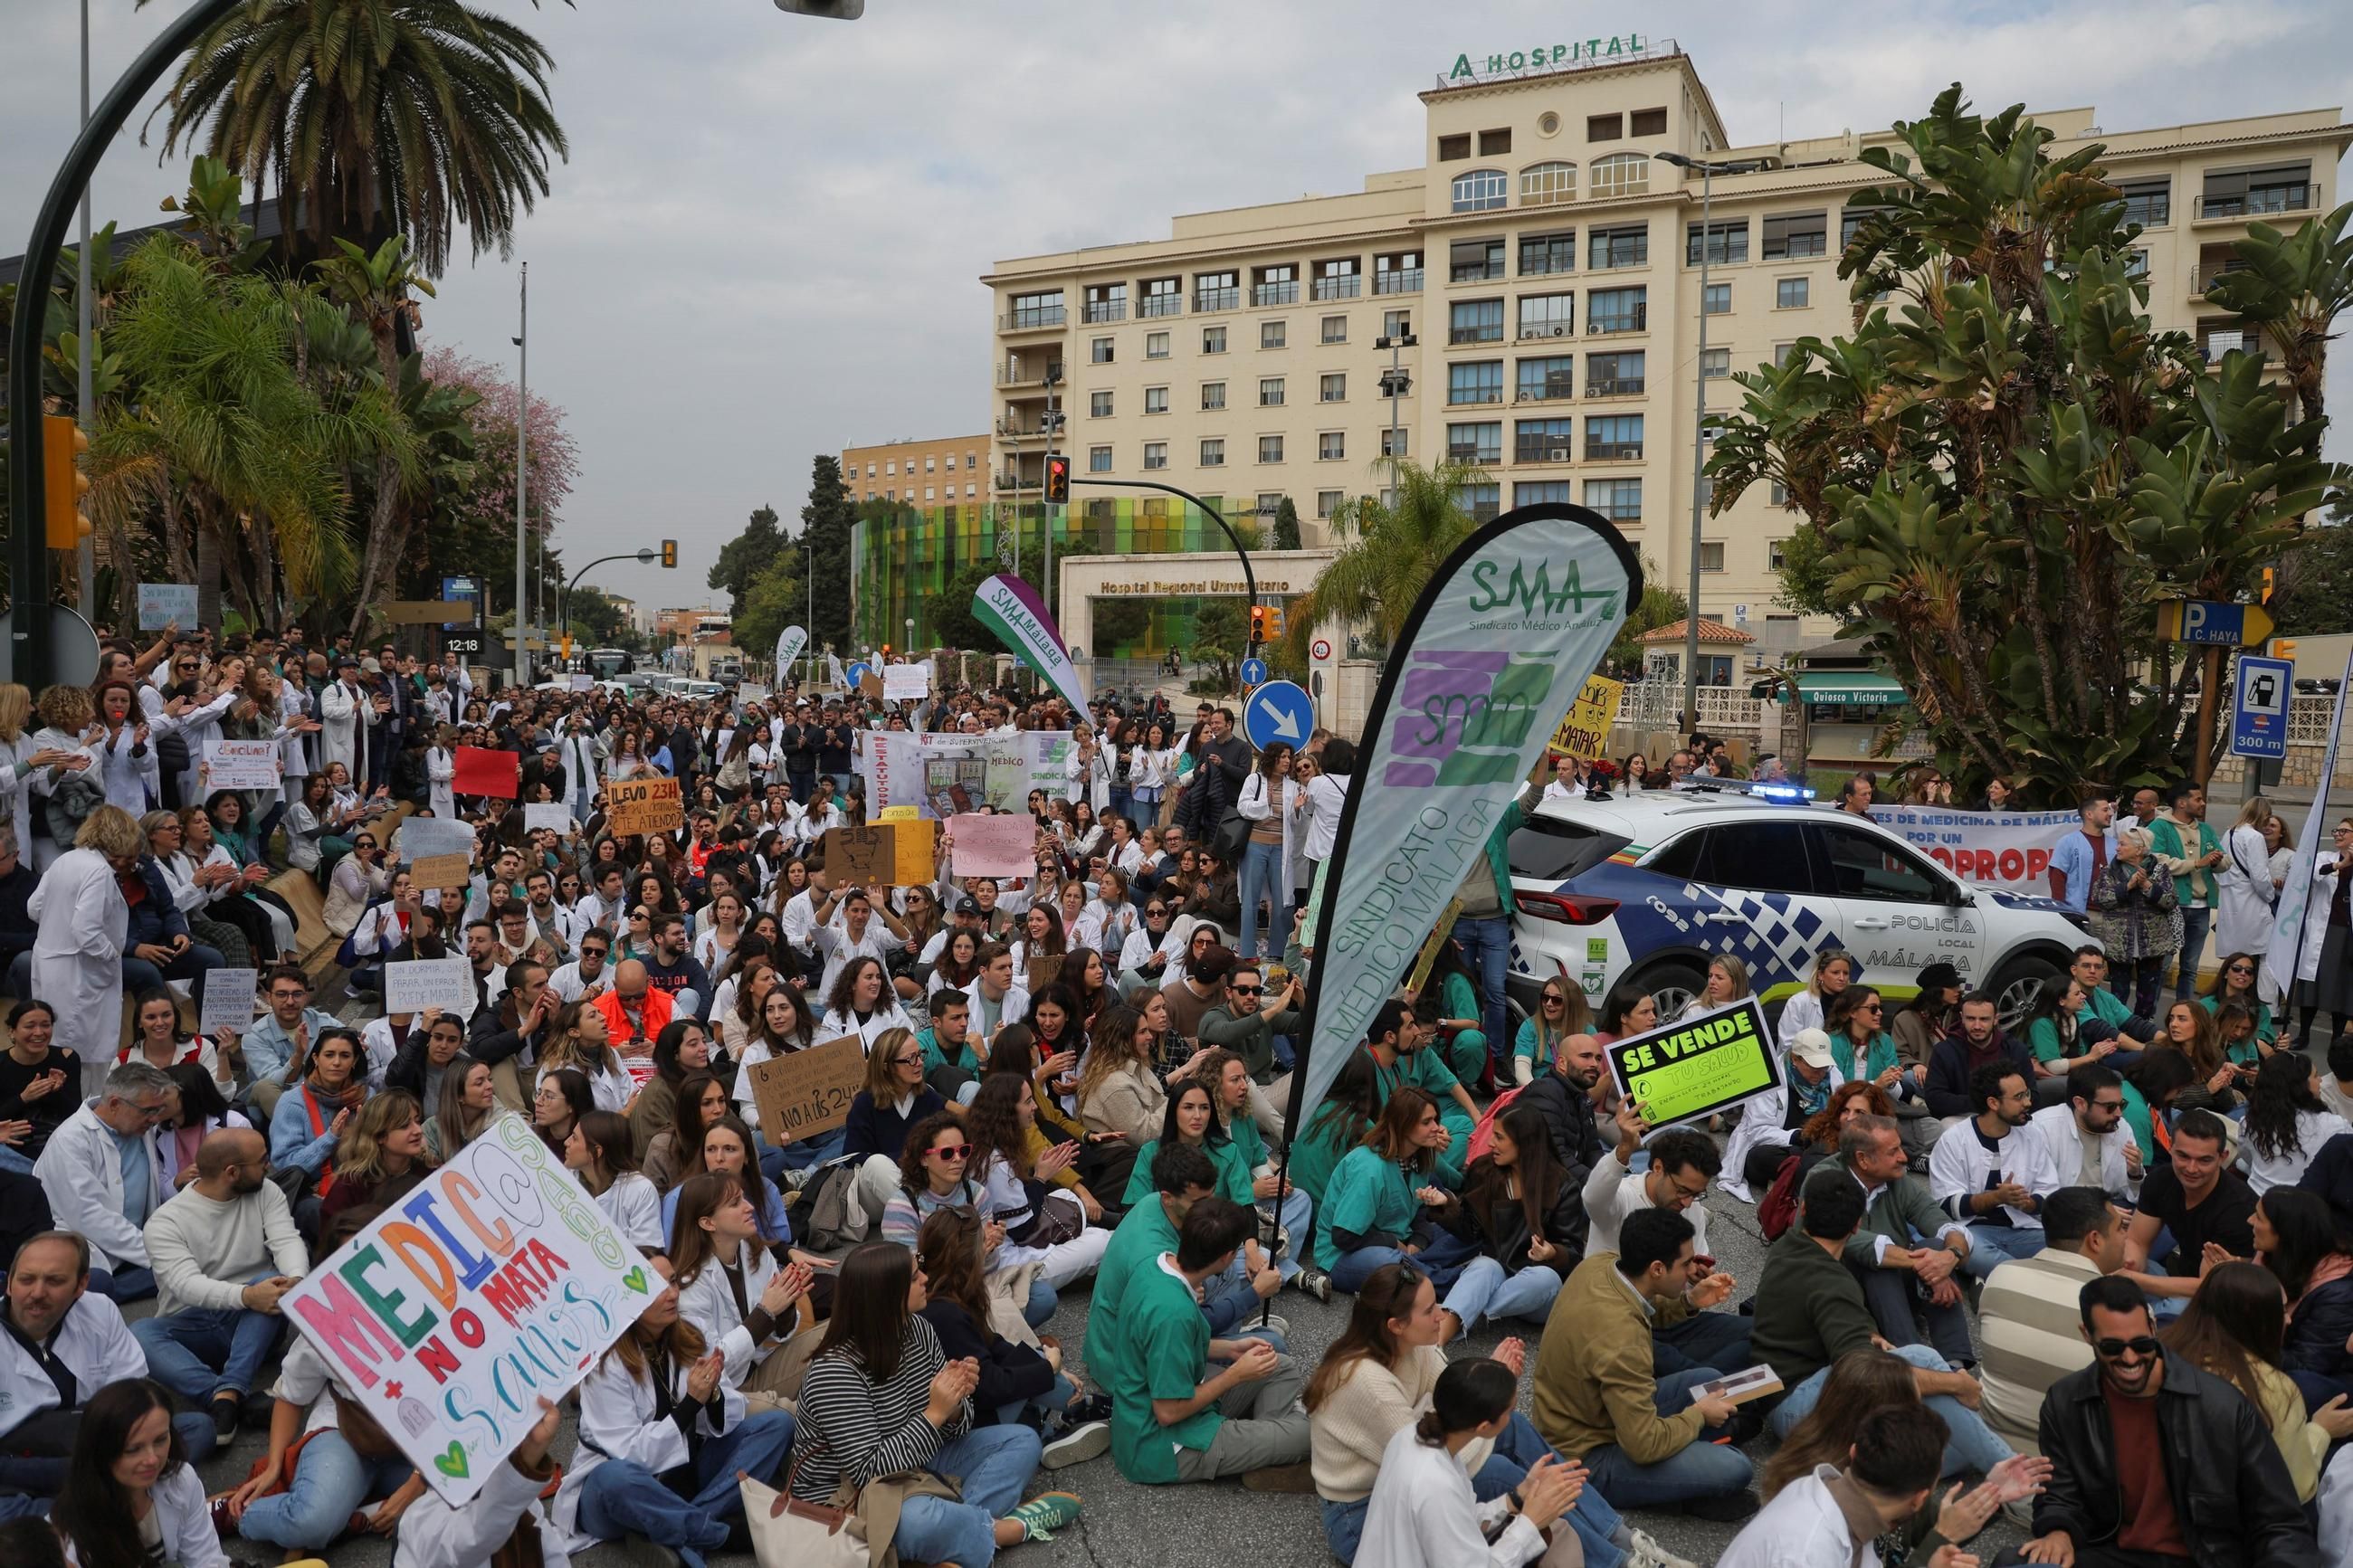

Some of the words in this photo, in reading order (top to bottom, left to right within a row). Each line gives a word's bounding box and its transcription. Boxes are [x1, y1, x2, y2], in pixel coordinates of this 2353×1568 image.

[1488, 33, 1643, 73] HOSPITAL
[1101, 582, 1149, 594] Hospital
[1154, 581, 1206, 594] Regional
[1210, 580, 1289, 593] Univeritario
[1470, 556, 1586, 619] SMA
[1470, 620, 1518, 631] Sindicato
[1521, 620, 1560, 631] Médico
[2184, 603, 2206, 640] P
[1024, 617, 1062, 666] Málaga
[2195, 629, 2205, 641] C.
[2209, 631, 2239, 642] HAYA
[448, 640, 478, 651] 12:18
[1814, 691, 1846, 702] Quiosco
[1853, 691, 1888, 702] Victoria
[920, 734, 933, 746] KIT
[938, 736, 947, 746] de
[949, 737, 1008, 746] SUPERVIVENCIA
[1558, 723, 1601, 757] MATAR
[2238, 736, 2263, 747] 300
[2268, 740, 2281, 749] m
[993, 746, 1005, 755] del
[991, 754, 1024, 766] MÉDICO
[1031, 772, 1068, 780] SINDICA
[652, 782, 678, 800] 23H
[639, 812, 681, 830] ATIENDO?
[1897, 813, 1917, 824] DE
[1921, 814, 1996, 825] MEDICINA
[2001, 818, 2022, 826] DE
[2027, 813, 2083, 825] MÁLAG
[1907, 832, 1937, 842] POR
[1942, 833, 1962, 843] UN
[1336, 806, 1448, 959] SINDICATO
[1891, 915, 1977, 933] POLICÍA
[1938, 939, 1975, 948] LOCAL
[1866, 948, 1971, 972] MÁLAGA
[392, 966, 405, 974] SIN
[448, 965, 462, 973] SIN
[435, 978, 459, 986] ERROR
[1326, 924, 1415, 1042] MÉDICO
[398, 990, 427, 1005] PUEDE
[430, 989, 459, 1003] MATAR
[1623, 1044, 1656, 1072] SE
[1657, 1011, 1753, 1060] VENDE
[1665, 1067, 1694, 1086] TU
[1698, 1044, 1749, 1077] SALUD
[1693, 1078, 1742, 1101] TRABAJANDO
[781, 1107, 801, 1129] NO
[804, 1103, 813, 1124] A
[292, 1142, 544, 1390] MÉDIC@
[414, 1308, 485, 1384] NO
[480, 1237, 569, 1330] MATA
